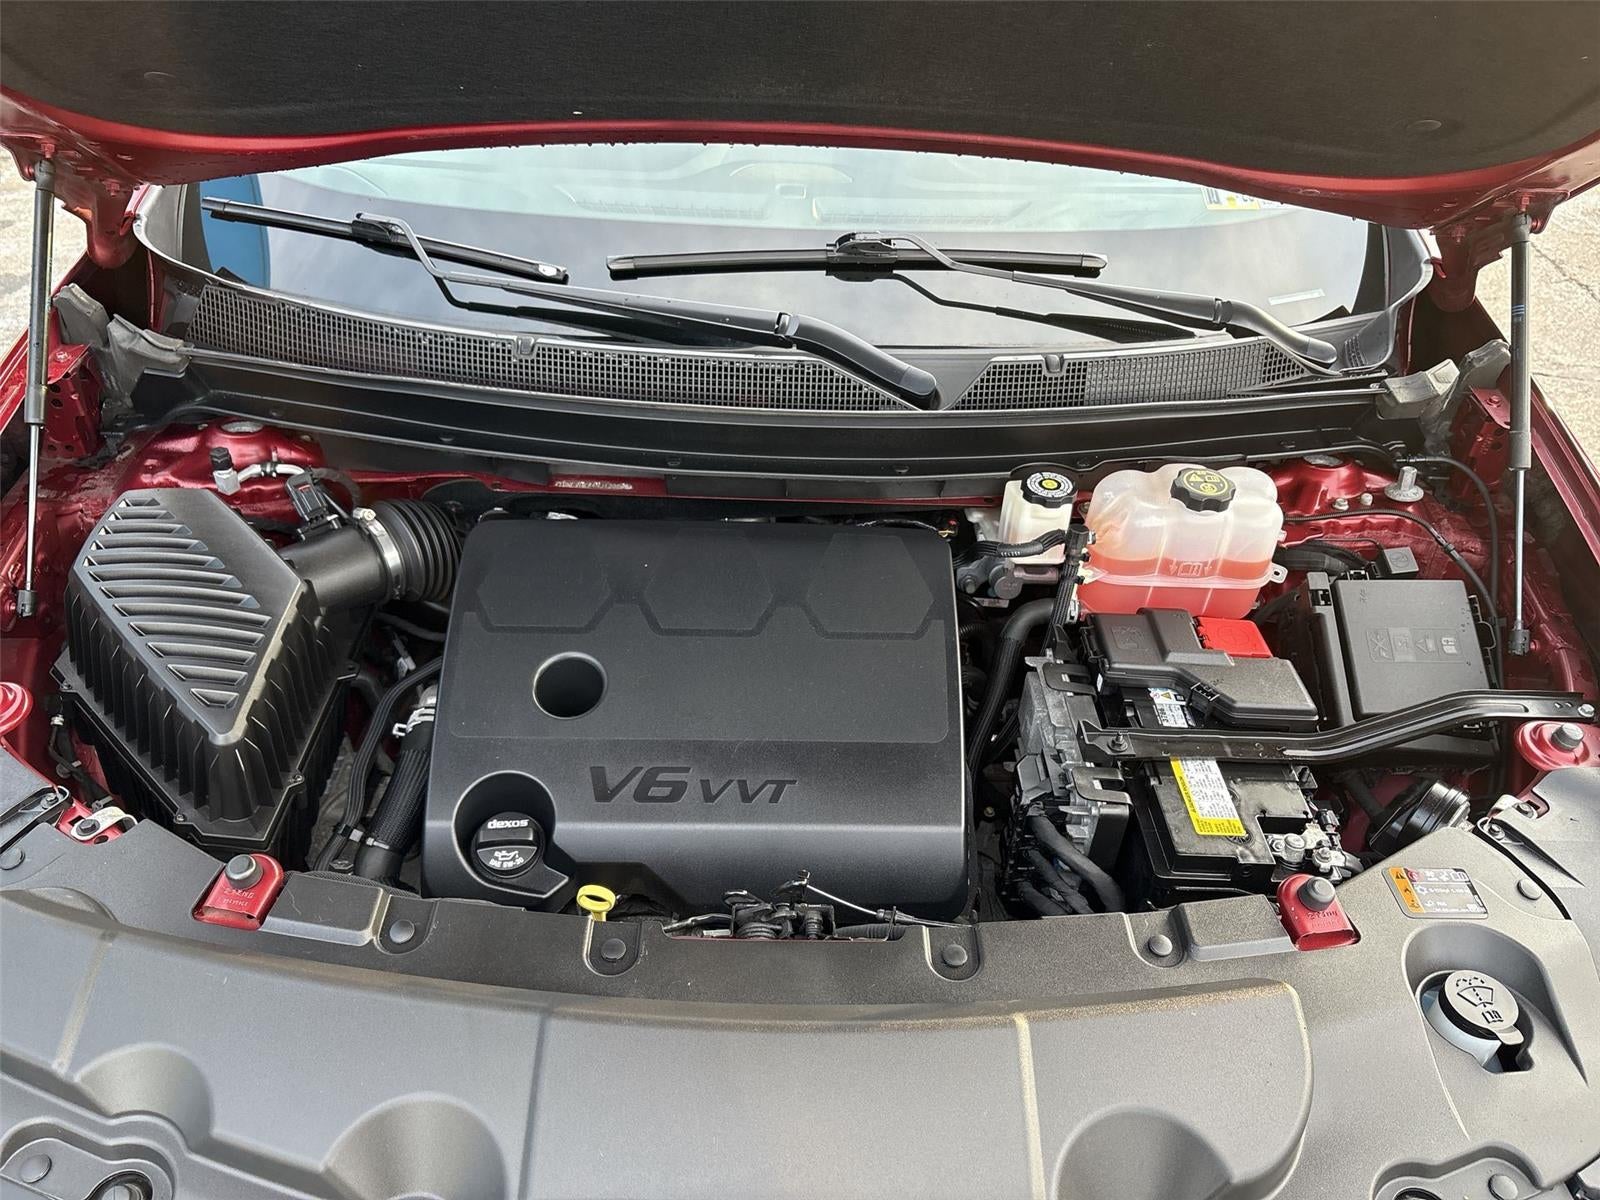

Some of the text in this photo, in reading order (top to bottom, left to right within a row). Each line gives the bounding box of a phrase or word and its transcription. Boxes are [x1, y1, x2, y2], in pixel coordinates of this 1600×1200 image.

[590, 766, 799, 804] V6 VVT
[487, 818, 530, 830] dexos
